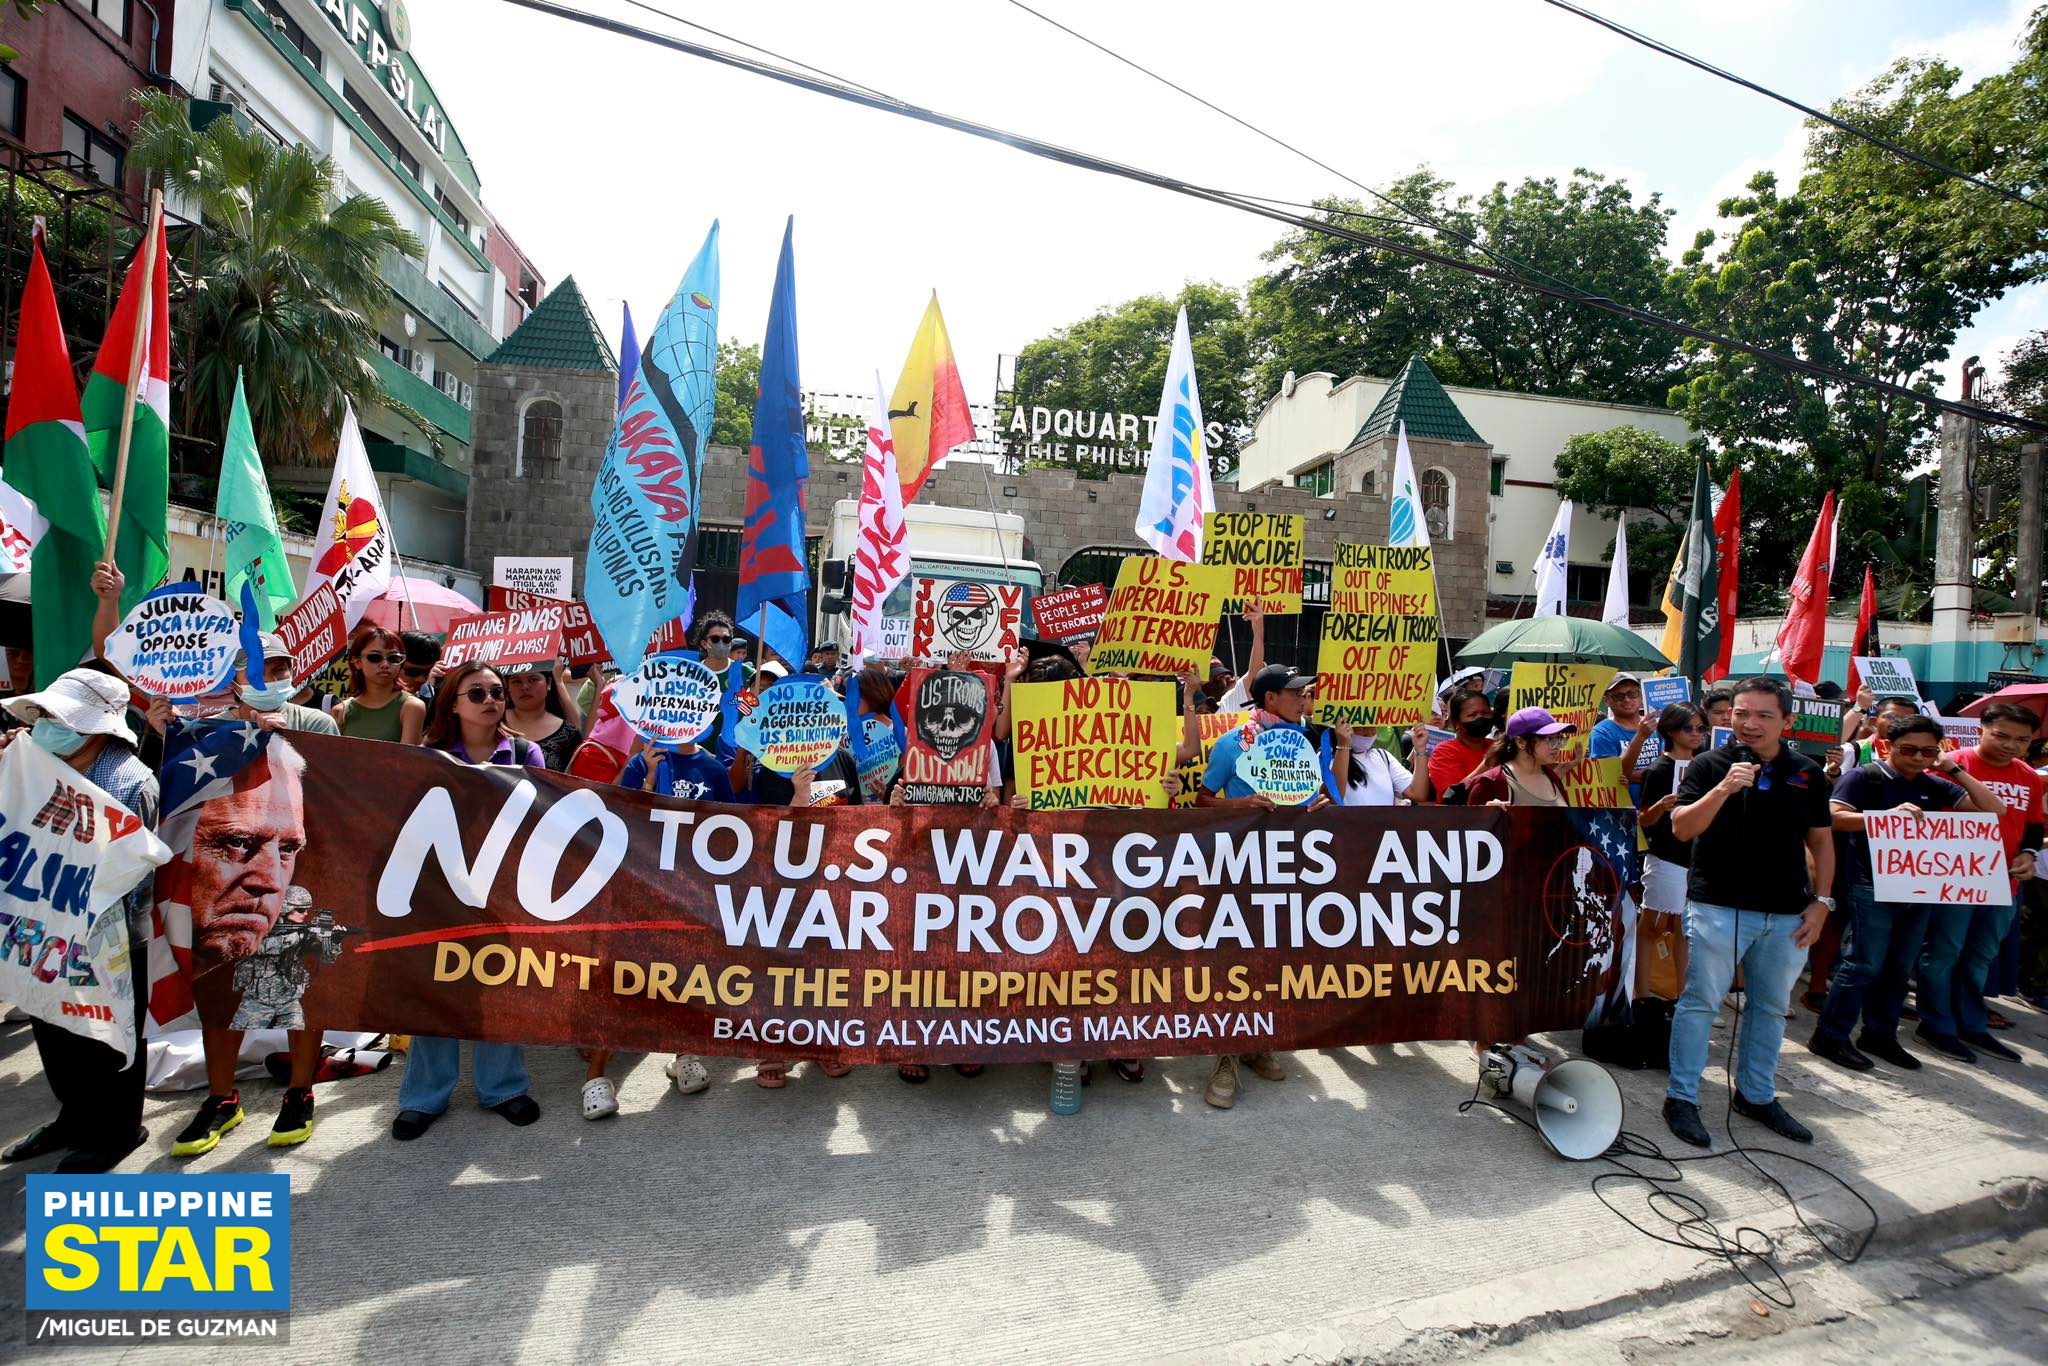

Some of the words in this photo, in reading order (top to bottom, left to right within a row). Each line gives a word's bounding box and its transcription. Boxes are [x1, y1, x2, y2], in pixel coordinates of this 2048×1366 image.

[968, 401, 1225, 450] HEADQUARTS
[1213, 512, 1263, 538] STOP
[1266, 514, 1294, 538] THE
[1202, 539, 1301, 567] GENOCIDE!
[1378, 546, 1431, 572] TROOPS
[505, 574, 562, 583] MAMAMAYAN!
[506, 568, 542, 576] HARAPIN
[544, 568, 562, 576] ANG
[927, 563, 951, 571] CAPITAL
[953, 566, 975, 574] REGION
[976, 568, 996, 577] POLICE
[1344, 569, 1371, 589] OUT
[1376, 571, 1392, 591] OF
[513, 580, 538, 589] ITIGIL
[540, 581, 555, 589] ANG
[140, 596, 207, 619] JUNK
[1034, 590, 1081, 610] SERVING
[1084, 585, 1102, 597] THE
[1106, 586, 1210, 617] IMPERIALIST
[1332, 590, 1428, 616] PHILIPPINES!
[293, 589, 339, 639] BALIKATAN
[452, 621, 481, 641] ATIN
[482, 617, 505, 637] ANG
[507, 606, 563, 635] PINAS
[881, 618, 898, 632] US
[913, 578, 935, 658] JUNK
[998, 585, 1021, 663] VFA!
[1039, 604, 1079, 625] PEOPLE
[136, 615, 183, 640] EDCA
[195, 615, 235, 635] VFA!
[1322, 613, 1399, 643] FOREIGN
[140, 632, 208, 652] OPPOSE
[504, 634, 550, 656] LAYAS!
[884, 634, 908, 647] OUT
[132, 646, 226, 666] IMPERIALIST
[512, 662, 533, 673] UPD
[1343, 645, 1382, 672] OUT
[1389, 645, 1410, 671] OF
[160, 663, 214, 680] WAR!
[643, 660, 719, 693] US-CHINA
[1868, 660, 1900, 677] EDCA,
[768, 685, 795, 703] NO
[804, 684, 826, 702] TO
[920, 679, 942, 709] US
[942, 676, 987, 714] TROOPS
[1063, 677, 1101, 712] NO
[1103, 677, 1132, 711] TO
[1314, 672, 1432, 702] PHILIPPINES!
[1864, 675, 1915, 693] IBASURA!
[635, 694, 721, 714] IMPERYALISTA
[768, 701, 830, 717] CHINESE
[1804, 701, 1841, 718] WITH
[649, 708, 703, 726] LAYAS!
[1195, 713, 1239, 741] UNK
[1793, 713, 1840, 735] STINE
[1017, 712, 1153, 753] BALIKATAN
[1257, 729, 1306, 749] NO-SAIL
[905, 746, 948, 783] OUT
[947, 744, 987, 783] NOW!
[1264, 746, 1299, 761] ZONE
[1270, 759, 1296, 769] PARA
[1298, 760, 1310, 769] SA
[1030, 746, 1169, 789] EXERCISES!
[1251, 765, 1270, 779] U.S.
[1031, 784, 1089, 810] BAYAN
[1256, 779, 1316, 792] TUTULAN!
[1982, 780, 2031, 800] ERVE
[32, 779, 96, 844] NO
[1866, 815, 2001, 842] IMPERYALISMO
[376, 778, 630, 922] NO
[649, 808, 754, 875] TO
[773, 821, 908, 884] U.S.
[930, 828, 1098, 889] WAR
[1111, 829, 1336, 889] GAMES
[1369, 829, 1504, 884] AND
[1939, 883, 1988, 904] KMU
[714, 884, 895, 952] WAR
[912, 889, 1462, 955] PROVOCATIONS!
[433, 940, 600, 990] DON'T
[612, 960, 755, 1006] DRAG
[767, 966, 852, 1008] THE
[862, 968, 1119, 1009] PHILIPPINES
[1130, 966, 1172, 1005] IN
[1182, 961, 1392, 1004] U.S.-MADE
[1402, 958, 1518, 995] WARS!
[712, 1016, 866, 1047] BAGONG
[875, 1015, 1073, 1048] ALYANSANG
[1083, 1011, 1275, 1043] MAKABAYAN
